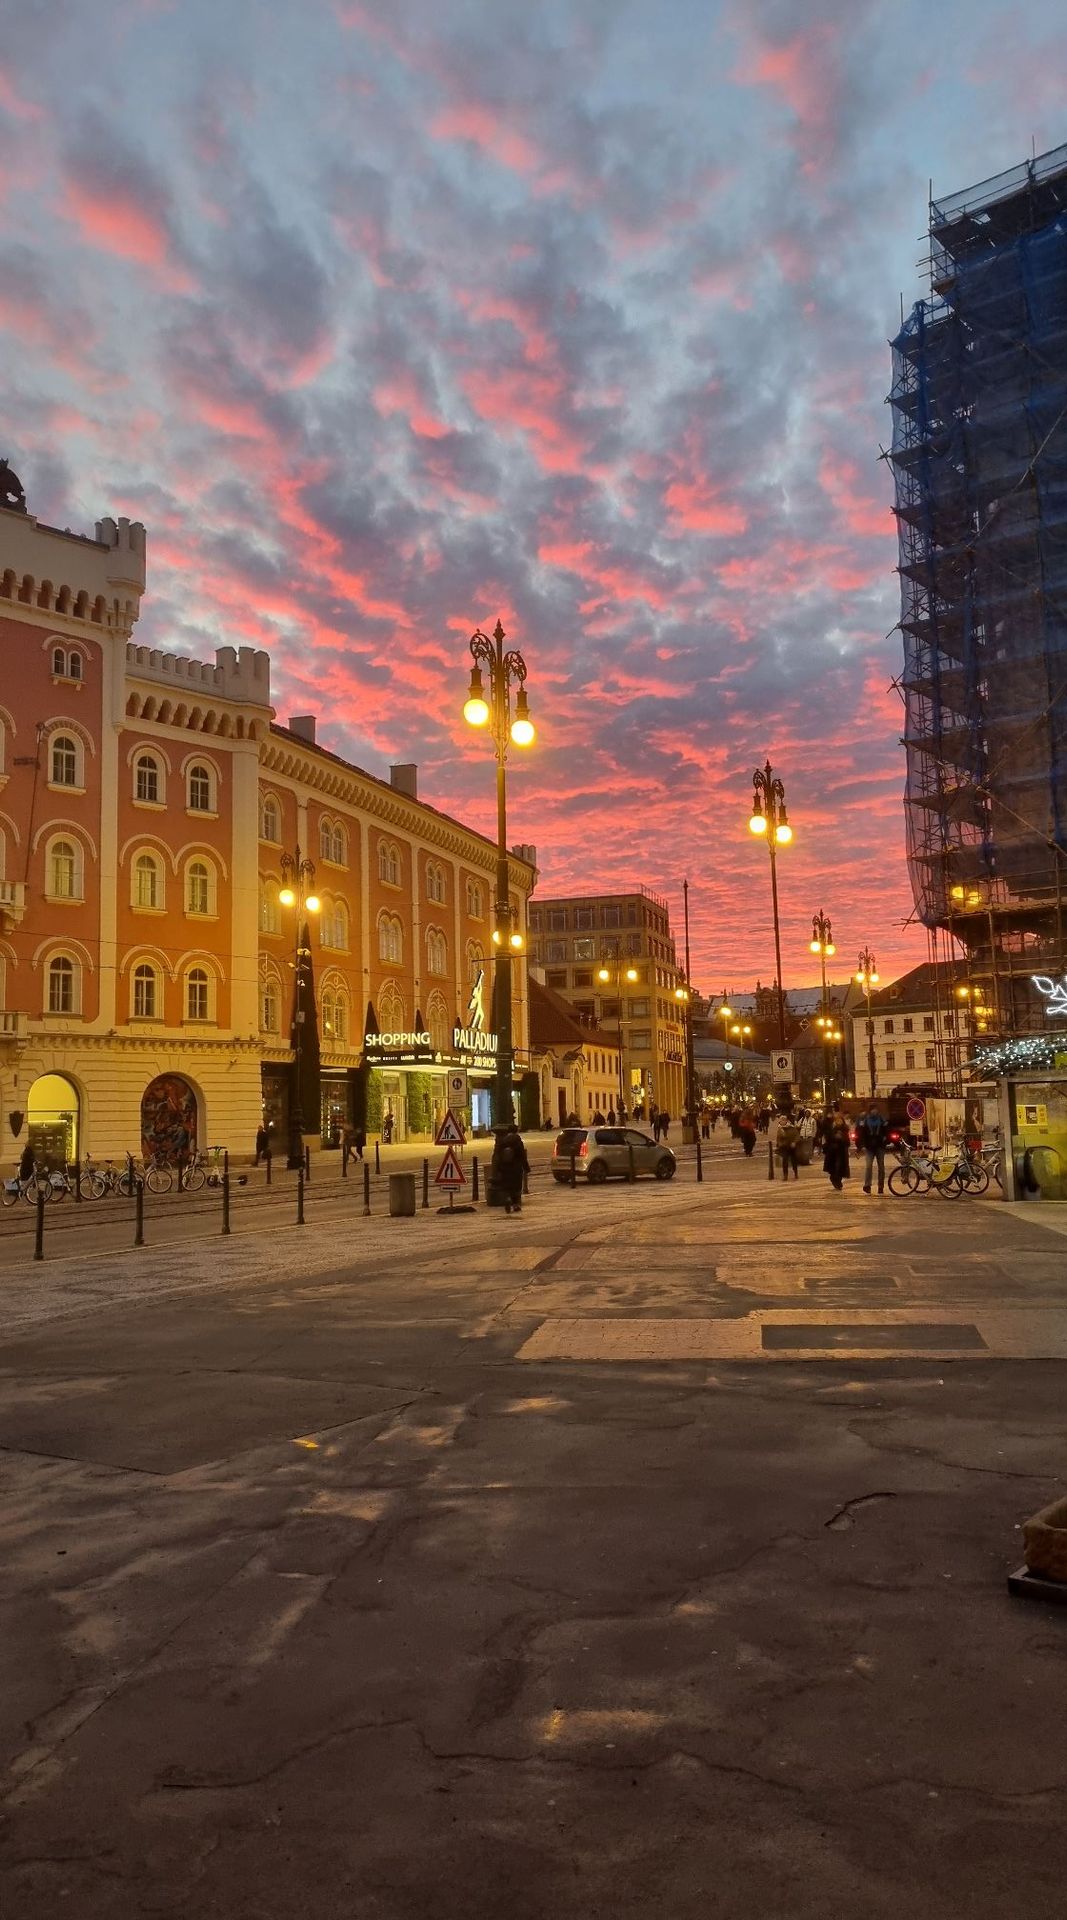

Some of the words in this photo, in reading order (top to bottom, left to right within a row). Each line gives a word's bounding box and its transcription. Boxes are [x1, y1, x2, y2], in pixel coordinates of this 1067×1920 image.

[365, 1031, 431, 1046] SHOPPING
[454, 1028, 498, 1052] PALLADIU
[482, 1056, 497, 1068] SHOPS
